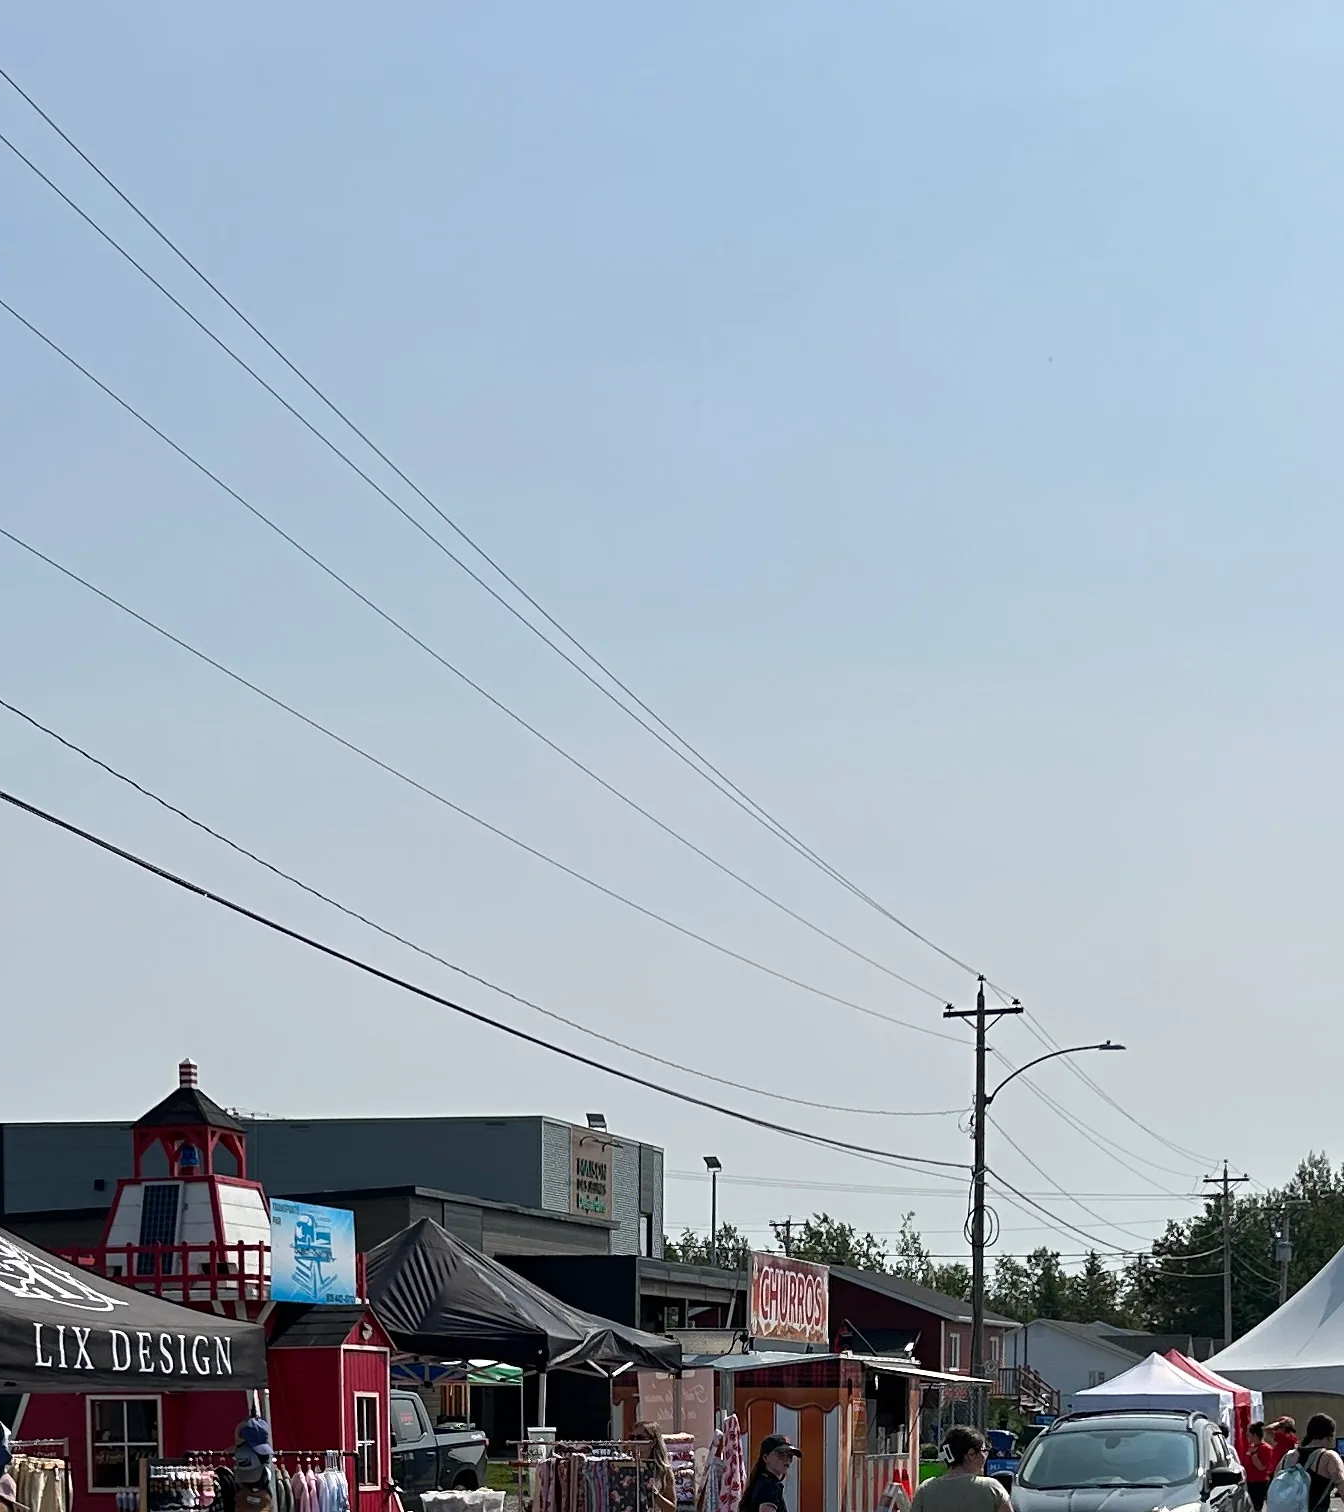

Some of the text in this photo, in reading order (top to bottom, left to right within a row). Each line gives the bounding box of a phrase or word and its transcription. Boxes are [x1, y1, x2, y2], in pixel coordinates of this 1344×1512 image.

[759, 1266, 823, 1328] CHURROS
[32, 1322, 234, 1376] LIX DESIGN
